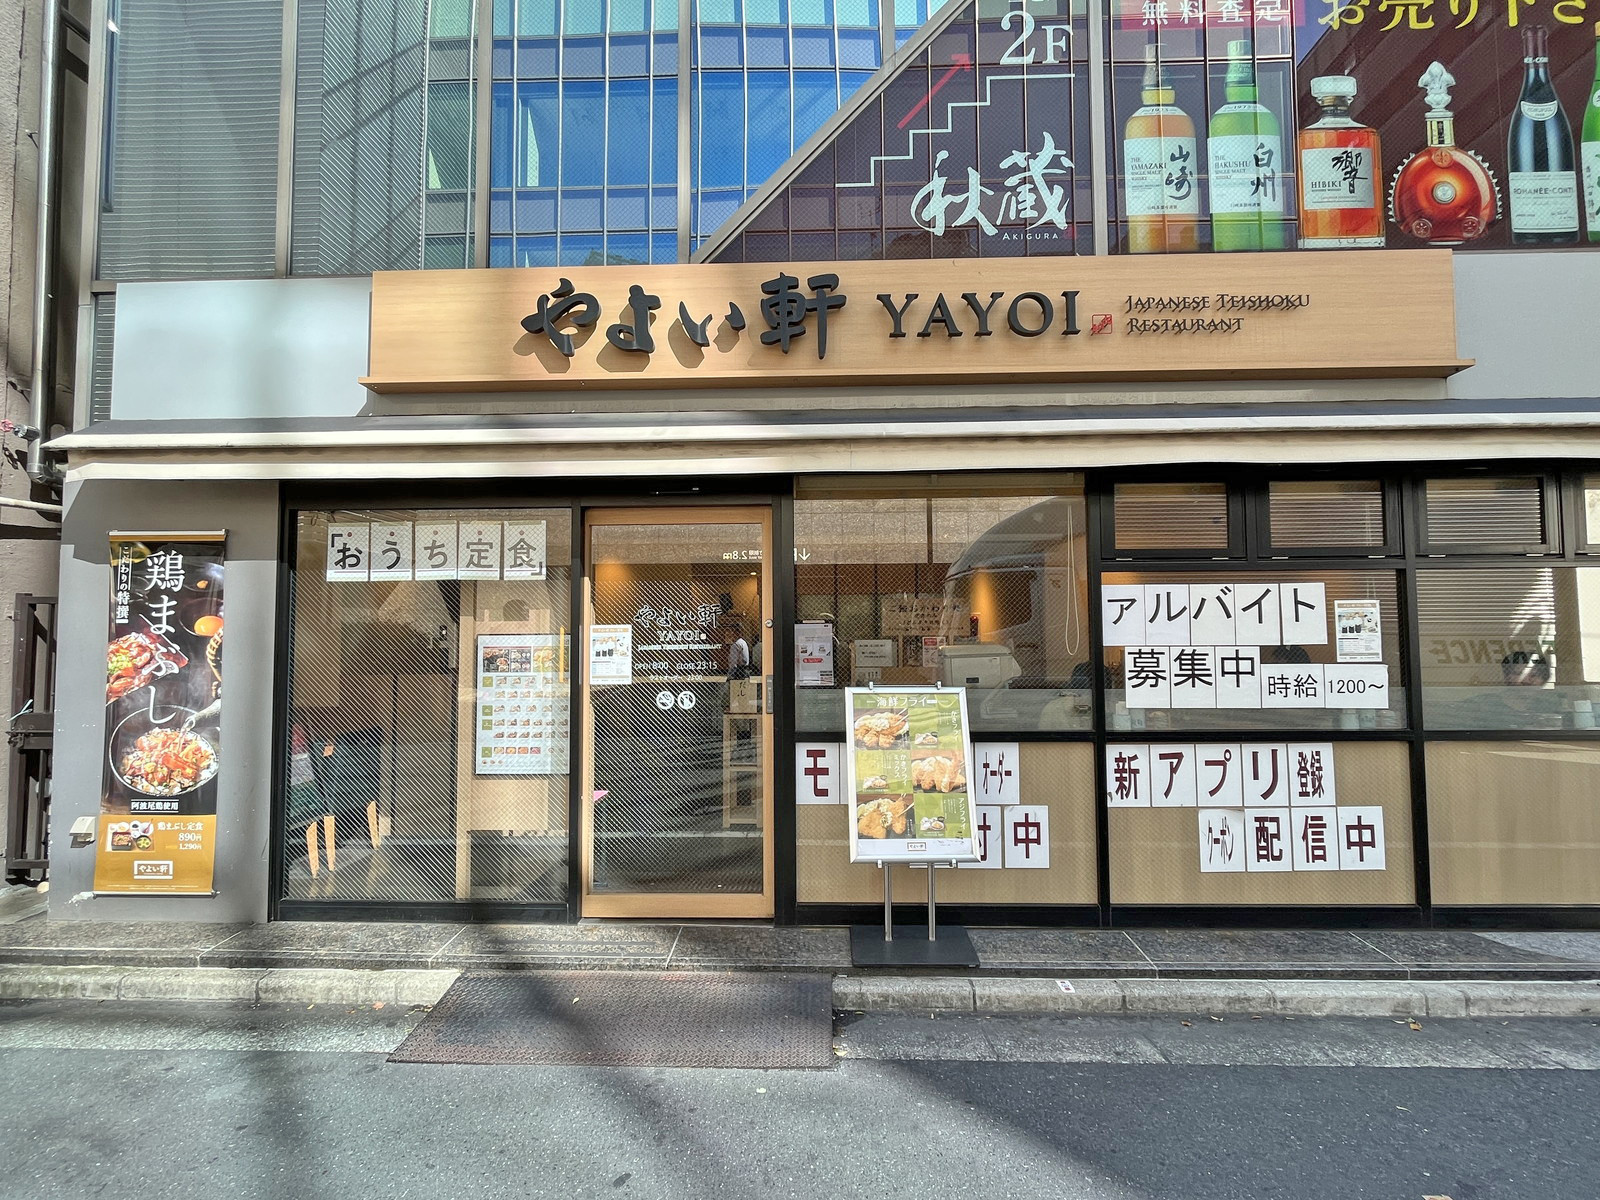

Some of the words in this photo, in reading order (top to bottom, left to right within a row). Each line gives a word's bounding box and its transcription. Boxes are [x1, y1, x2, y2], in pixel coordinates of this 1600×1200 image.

[1000, 11, 1073, 64] 2F
[1250, 142, 1276, 202] 白州
[1002, 232, 1059, 240] AKIGURA
[521, 272, 847, 360] やよい軒
[876, 290, 1081, 338] YAYOI
[1126, 295, 1211, 310] JAPANESE
[1216, 294, 1310, 310] TEISHOKU
[1127, 317, 1245, 333] RESTAURANT
[331, 533, 543, 576] 「おうち定食」
[633, 602, 723, 629] やよい軒
[1107, 585, 1316, 625] アルバイト
[141, 550, 185, 724] 鶏まぶし
[657, 630, 700, 641] YAYOI
[1127, 649, 1256, 688] 募集中
[876, 696, 927, 707] 海鮮フライ
[1268, 673, 1318, 698] 時給
[1114, 749, 1325, 800] 新アプリ登録
[178, 833, 202, 841] 890円
[138, 864, 169, 873] やよい軒
